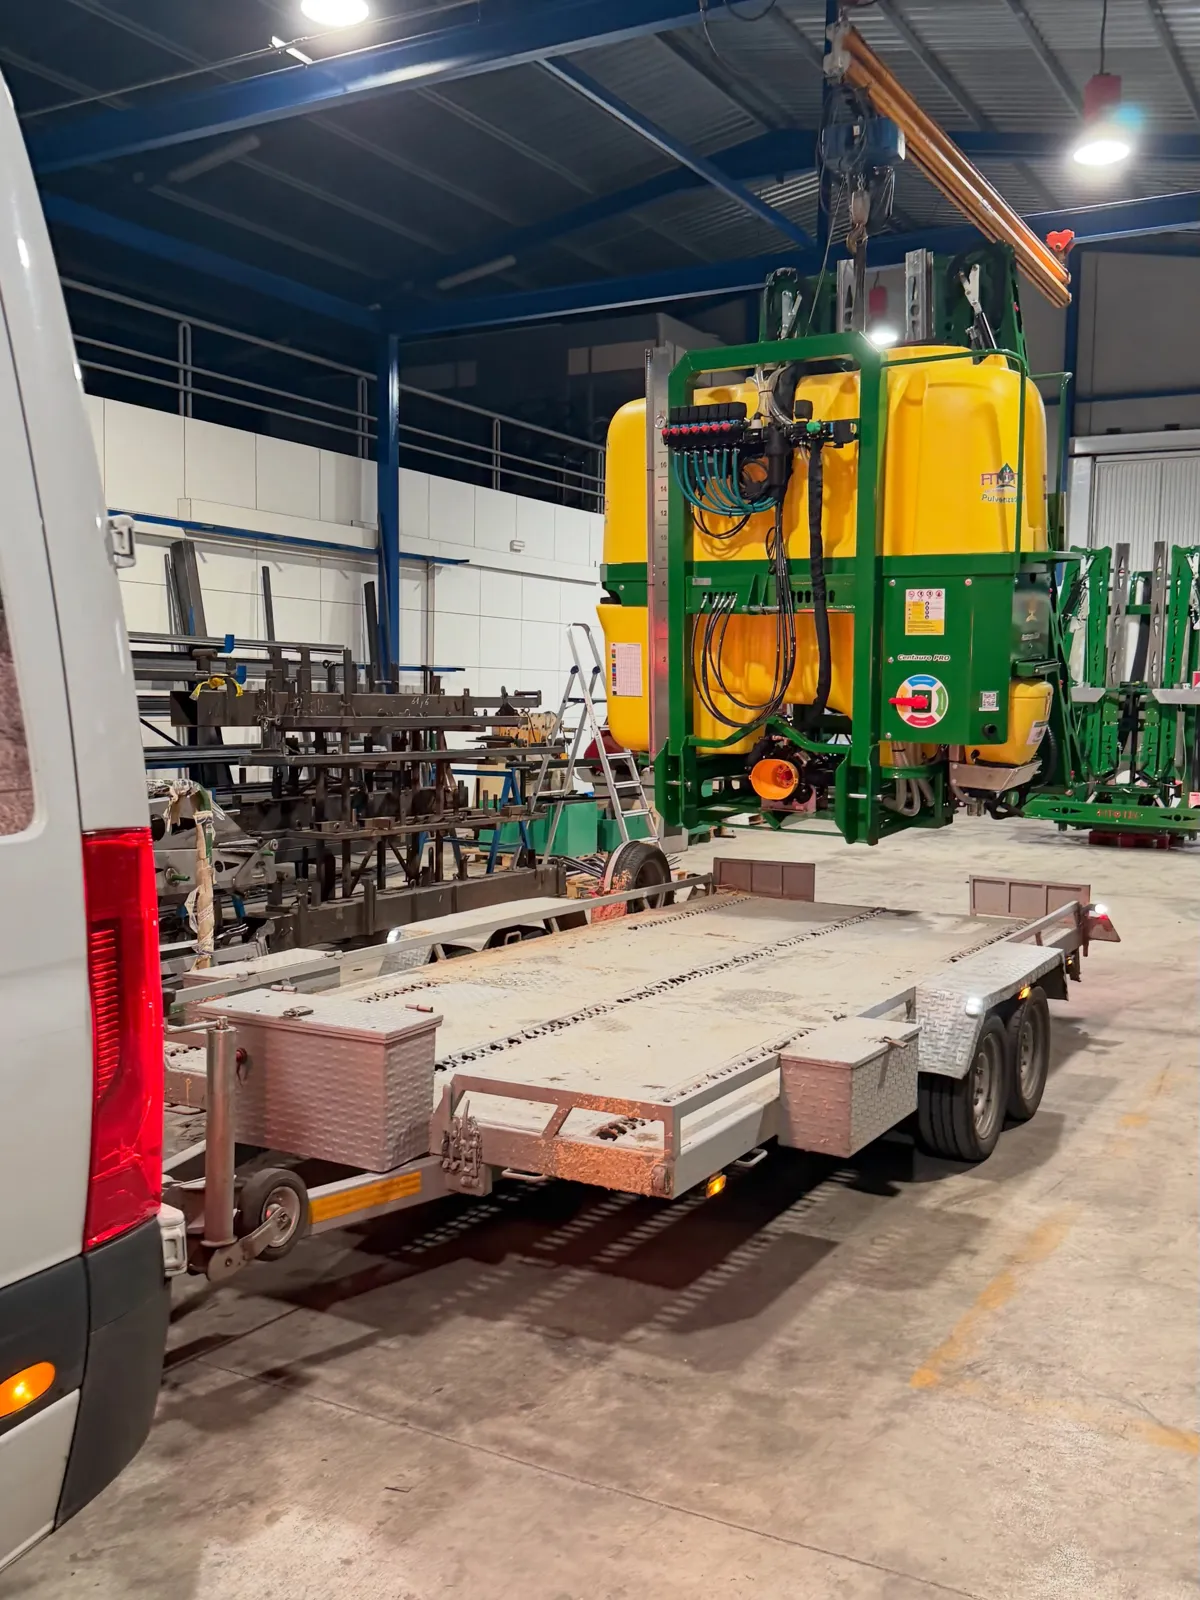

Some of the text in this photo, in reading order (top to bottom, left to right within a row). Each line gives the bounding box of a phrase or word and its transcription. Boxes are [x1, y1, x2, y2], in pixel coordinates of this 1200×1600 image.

[660, 509, 668, 517] 12
[662, 655, 667, 663] 2
[897, 653, 951, 662] Centauro PRO
